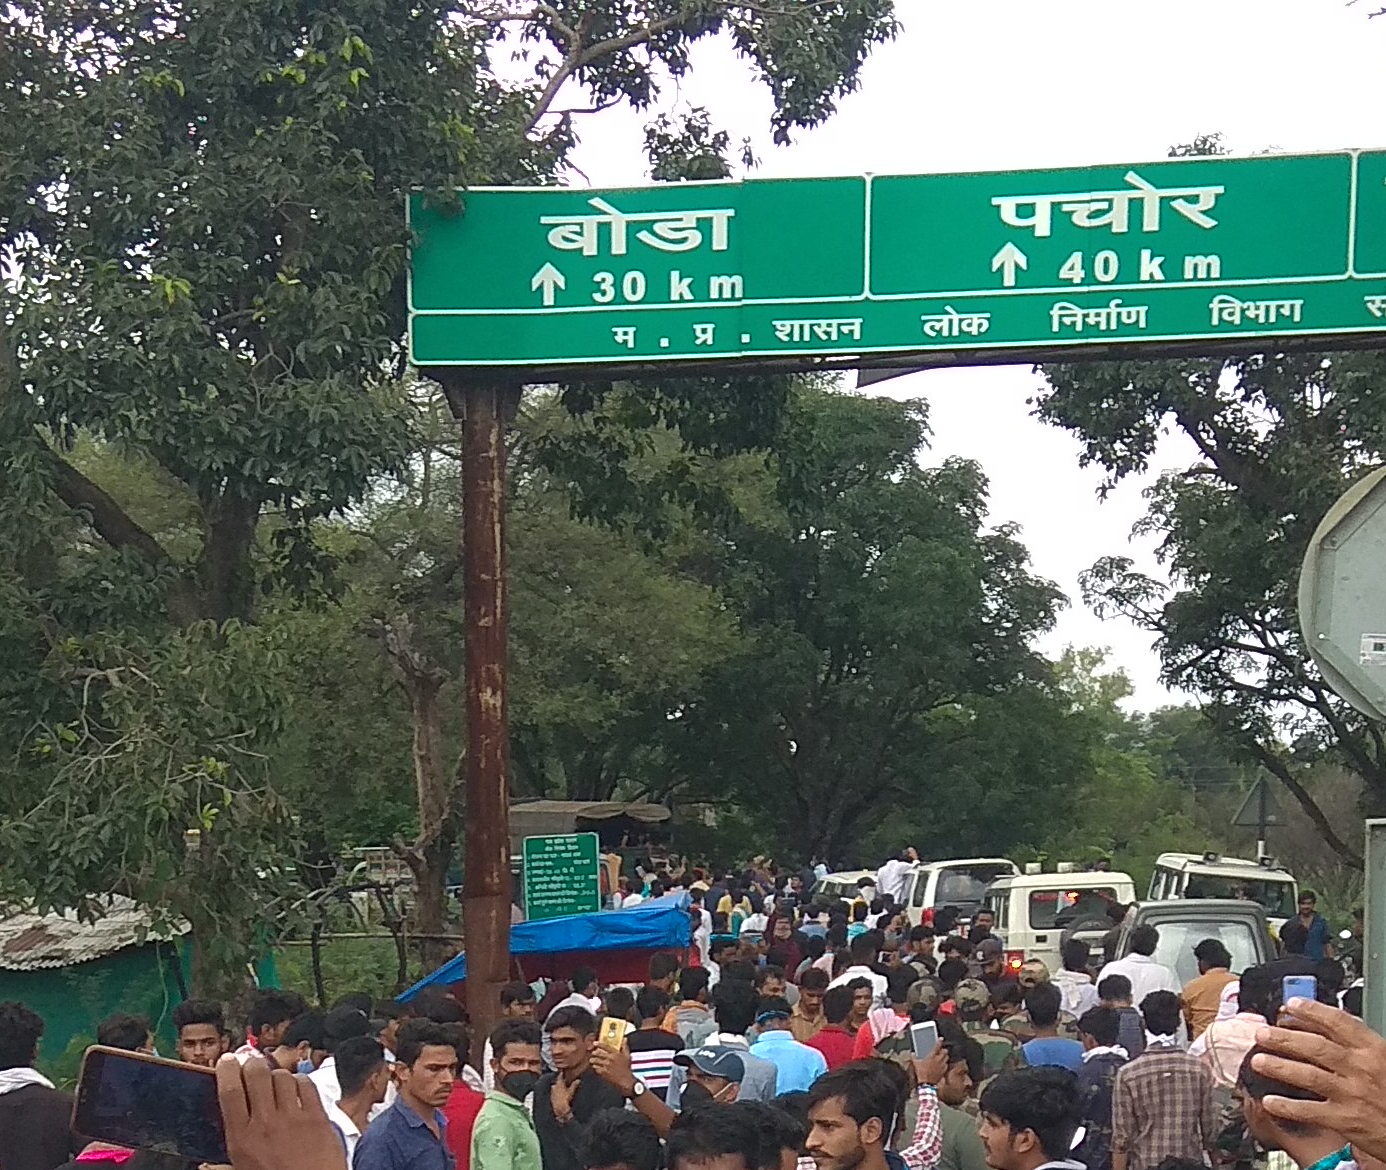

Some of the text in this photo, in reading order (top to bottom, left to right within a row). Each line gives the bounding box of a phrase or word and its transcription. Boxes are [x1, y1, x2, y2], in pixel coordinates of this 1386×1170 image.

[539, 197, 735, 257] बोडा
[991, 171, 1225, 237] पचोर
[591, 269, 646, 303] 30
[1058, 249, 1118, 285] 40
[772, 316, 863, 343] शासन
[921, 304, 991, 339] लोक
[1050, 299, 1148, 333] निर्माण
[1209, 294, 1304, 326] विभाग
